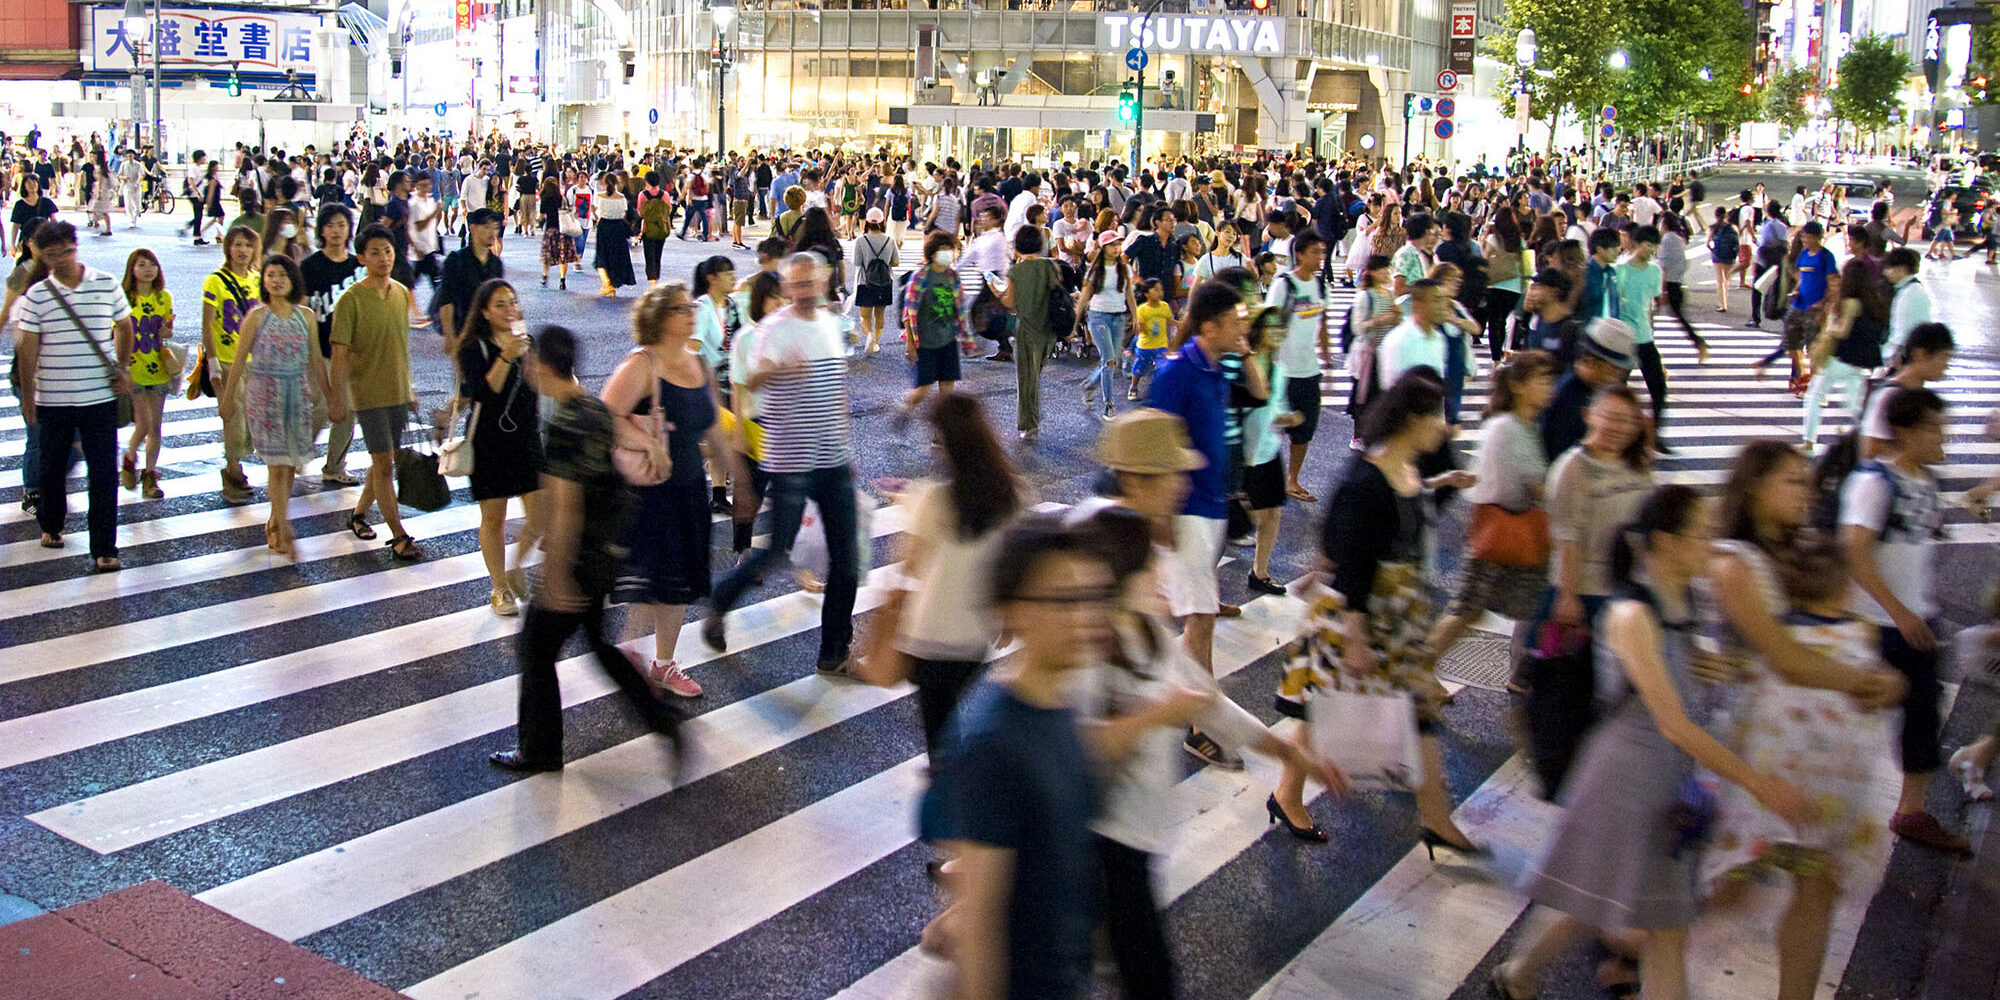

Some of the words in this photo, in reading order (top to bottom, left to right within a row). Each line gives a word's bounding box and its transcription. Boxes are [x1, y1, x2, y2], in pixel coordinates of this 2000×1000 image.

[105, 20, 311, 62] 大盛堂書店
[1104, 16, 1279, 53] TSUTAYA
[1455, 16, 1472, 33] 本
